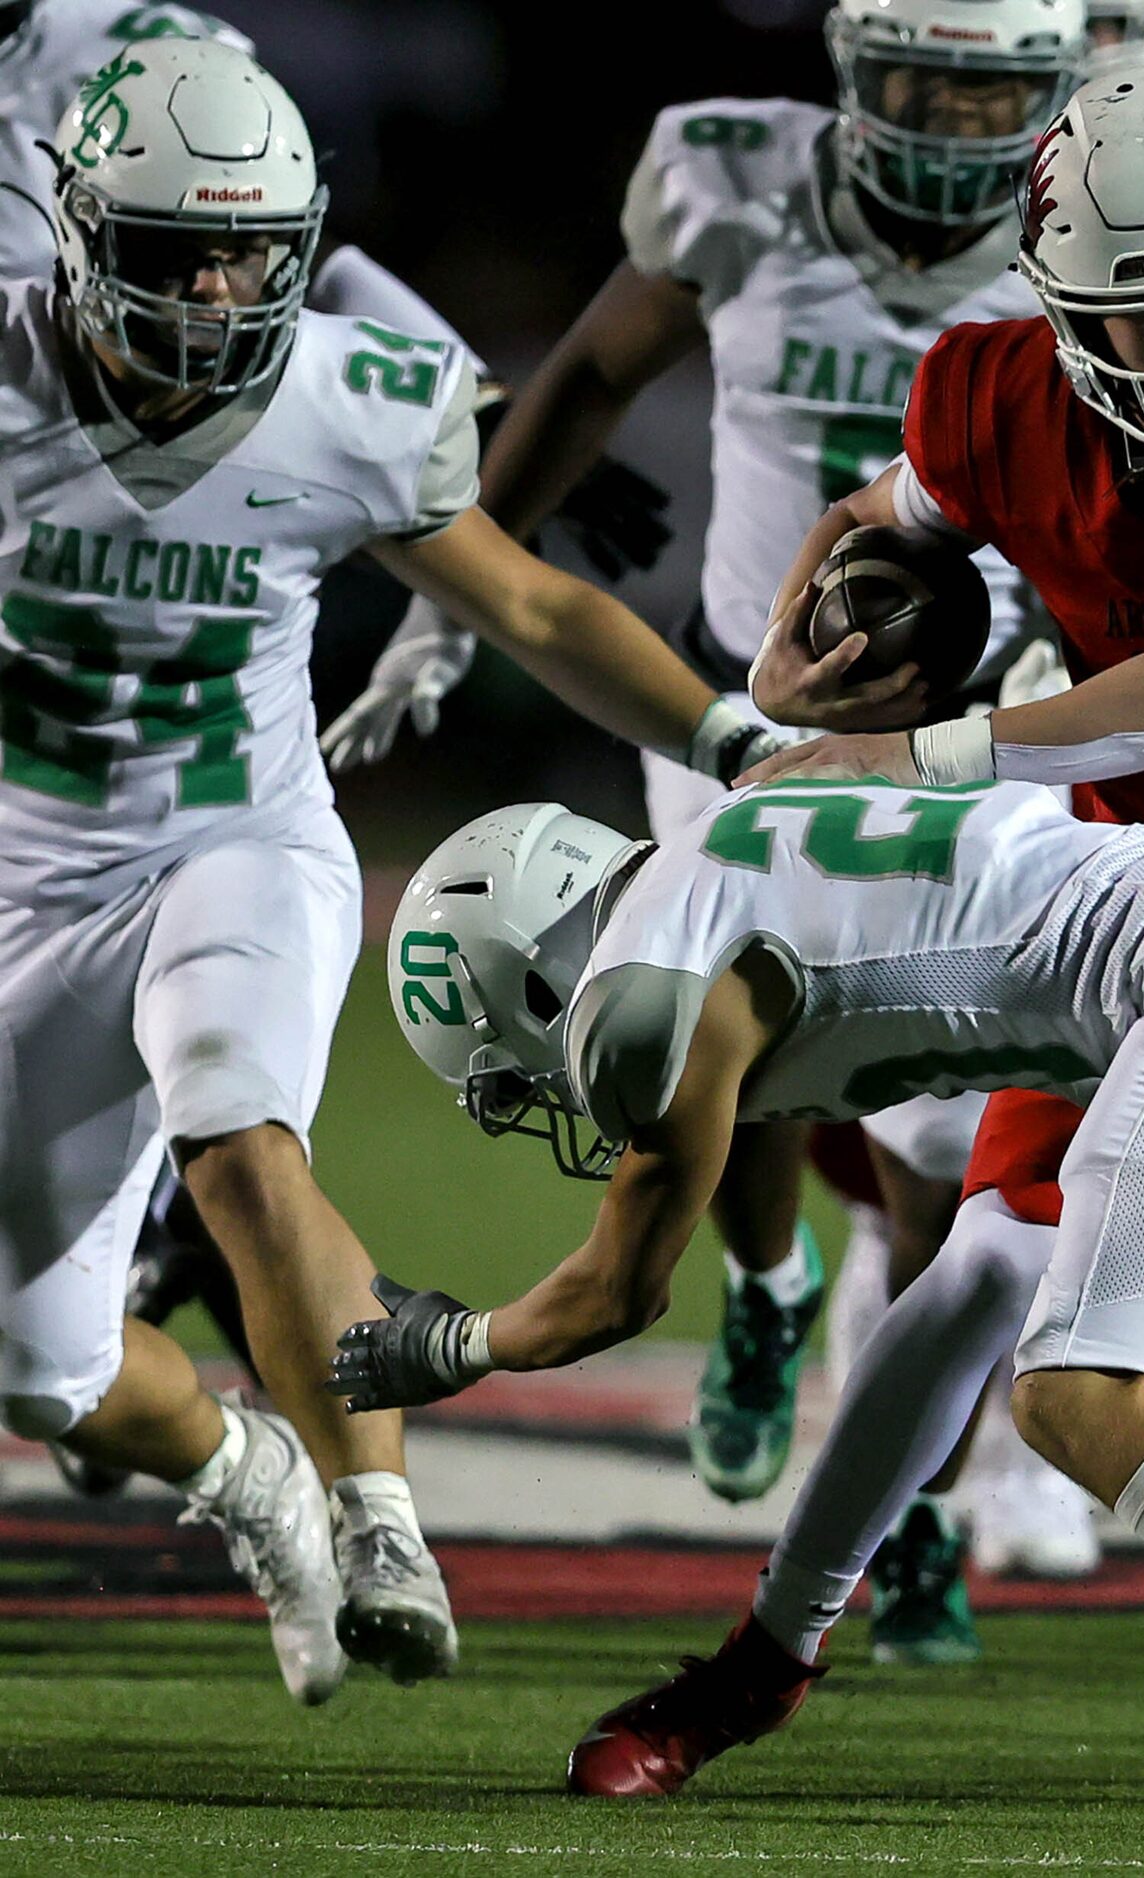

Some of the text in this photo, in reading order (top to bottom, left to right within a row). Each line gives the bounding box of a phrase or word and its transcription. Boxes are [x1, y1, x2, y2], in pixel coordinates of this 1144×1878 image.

[196, 188, 262, 202] Riddell
[19, 520, 262, 605] FALCONS
[0, 590, 253, 809] 24
[401, 930, 467, 1026] 20
